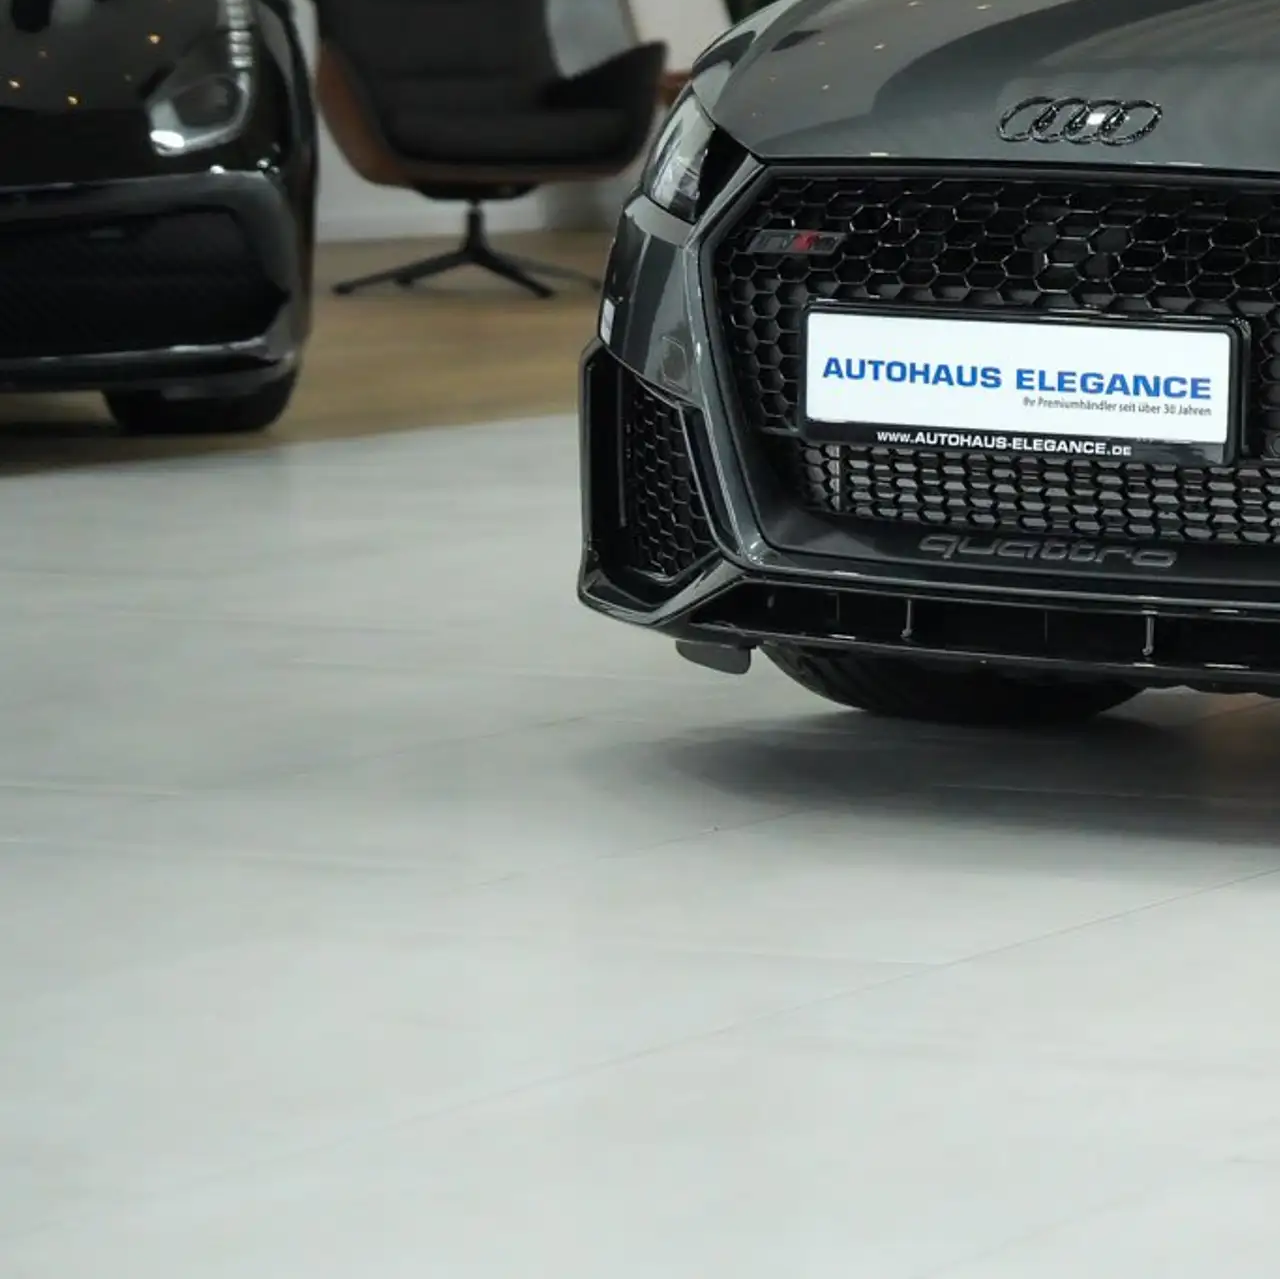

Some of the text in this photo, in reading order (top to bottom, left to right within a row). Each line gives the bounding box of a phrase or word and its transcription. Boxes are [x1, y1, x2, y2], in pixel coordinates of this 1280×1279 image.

[823, 357, 1211, 400] AUTOHAUS ELEGANCE
[1038, 396, 1117, 412] Premiumhändler
[1119, 402, 1136, 413] seit
[1138, 402, 1161, 414] über
[1178, 403, 1212, 417] Jahren
[918, 533, 1178, 568] quattro
